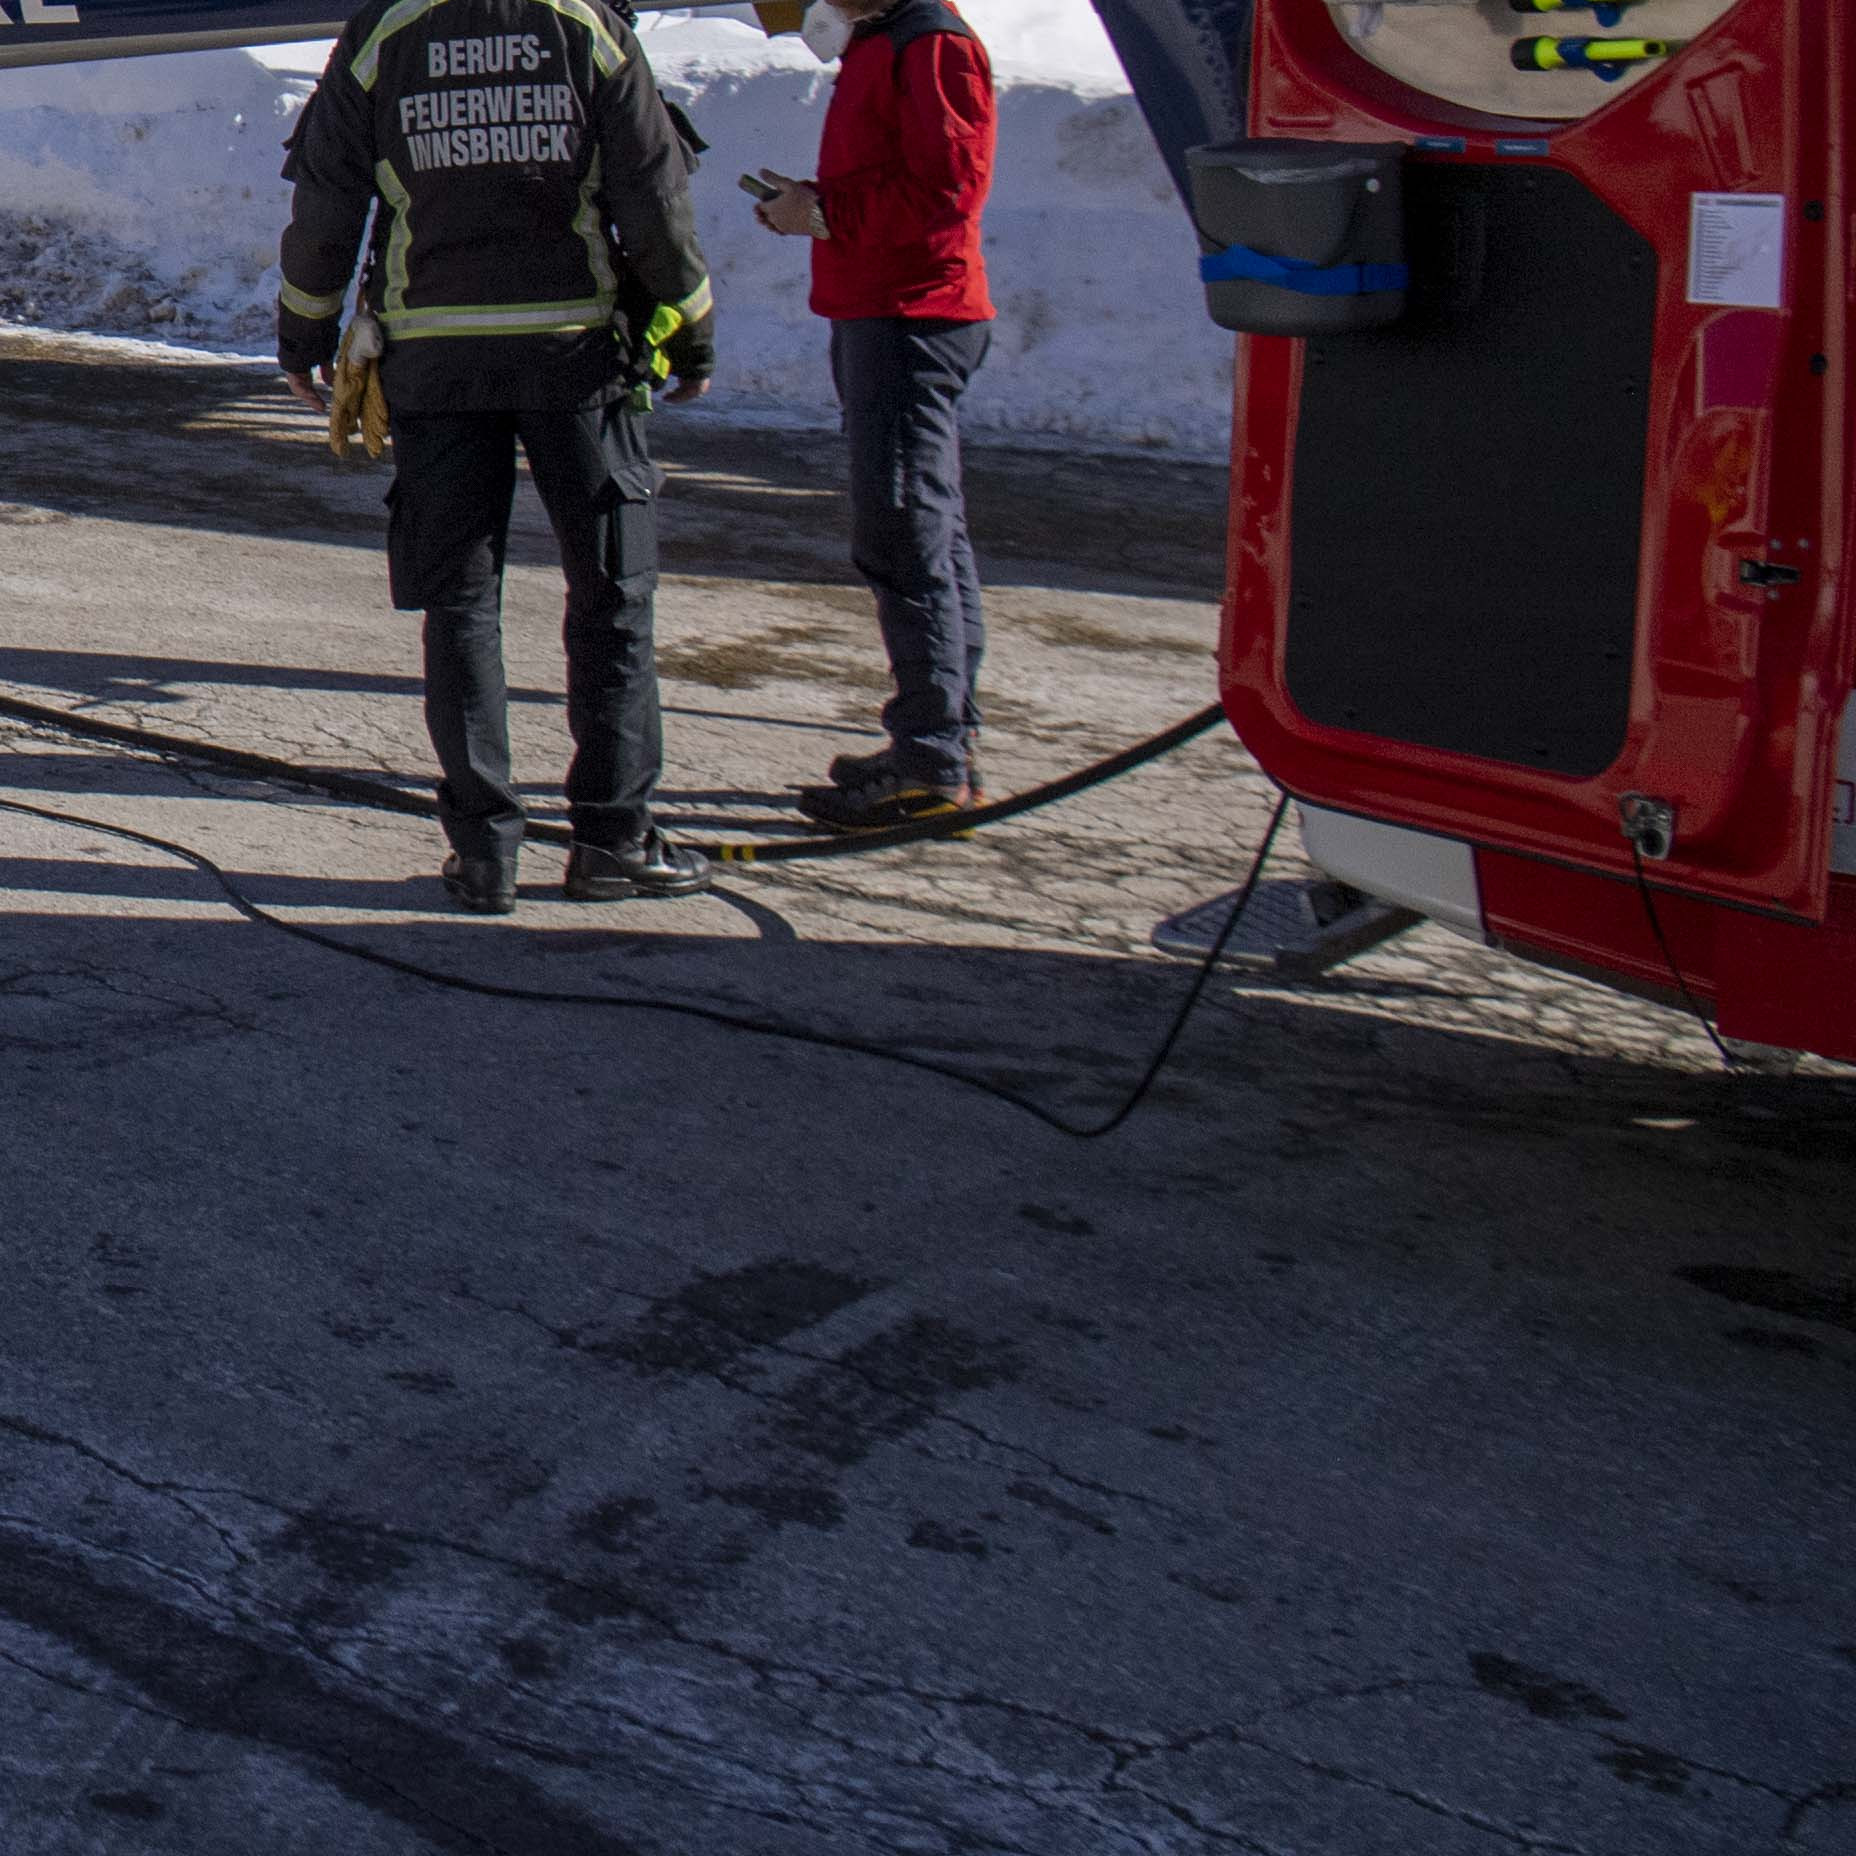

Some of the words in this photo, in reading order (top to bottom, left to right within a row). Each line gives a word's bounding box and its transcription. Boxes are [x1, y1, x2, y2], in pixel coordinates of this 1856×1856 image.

[427, 33, 552, 78] BERUFS-
[398, 84, 574, 134] FEUERWEHR
[406, 123, 573, 172] INNSBRUCK
